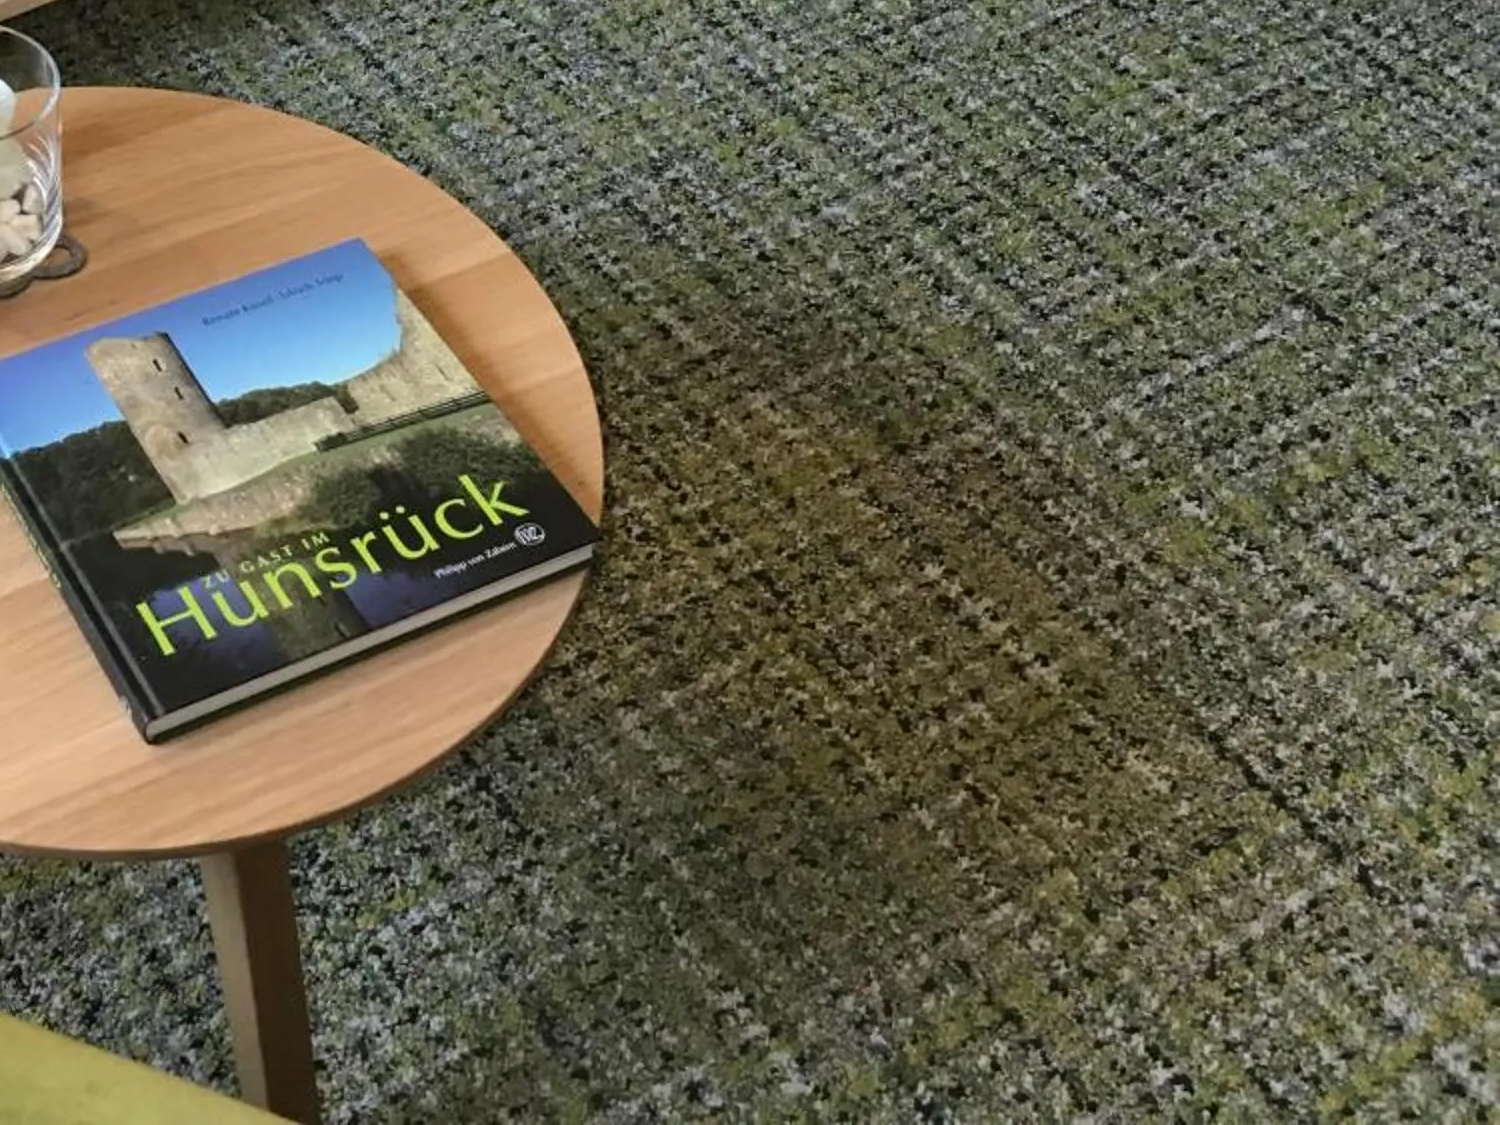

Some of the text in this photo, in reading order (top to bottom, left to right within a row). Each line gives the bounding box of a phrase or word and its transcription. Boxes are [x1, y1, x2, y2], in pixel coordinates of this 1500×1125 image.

[135, 474, 530, 657] Hunsrück
[202, 531, 330, 590] ZU GAST IM
